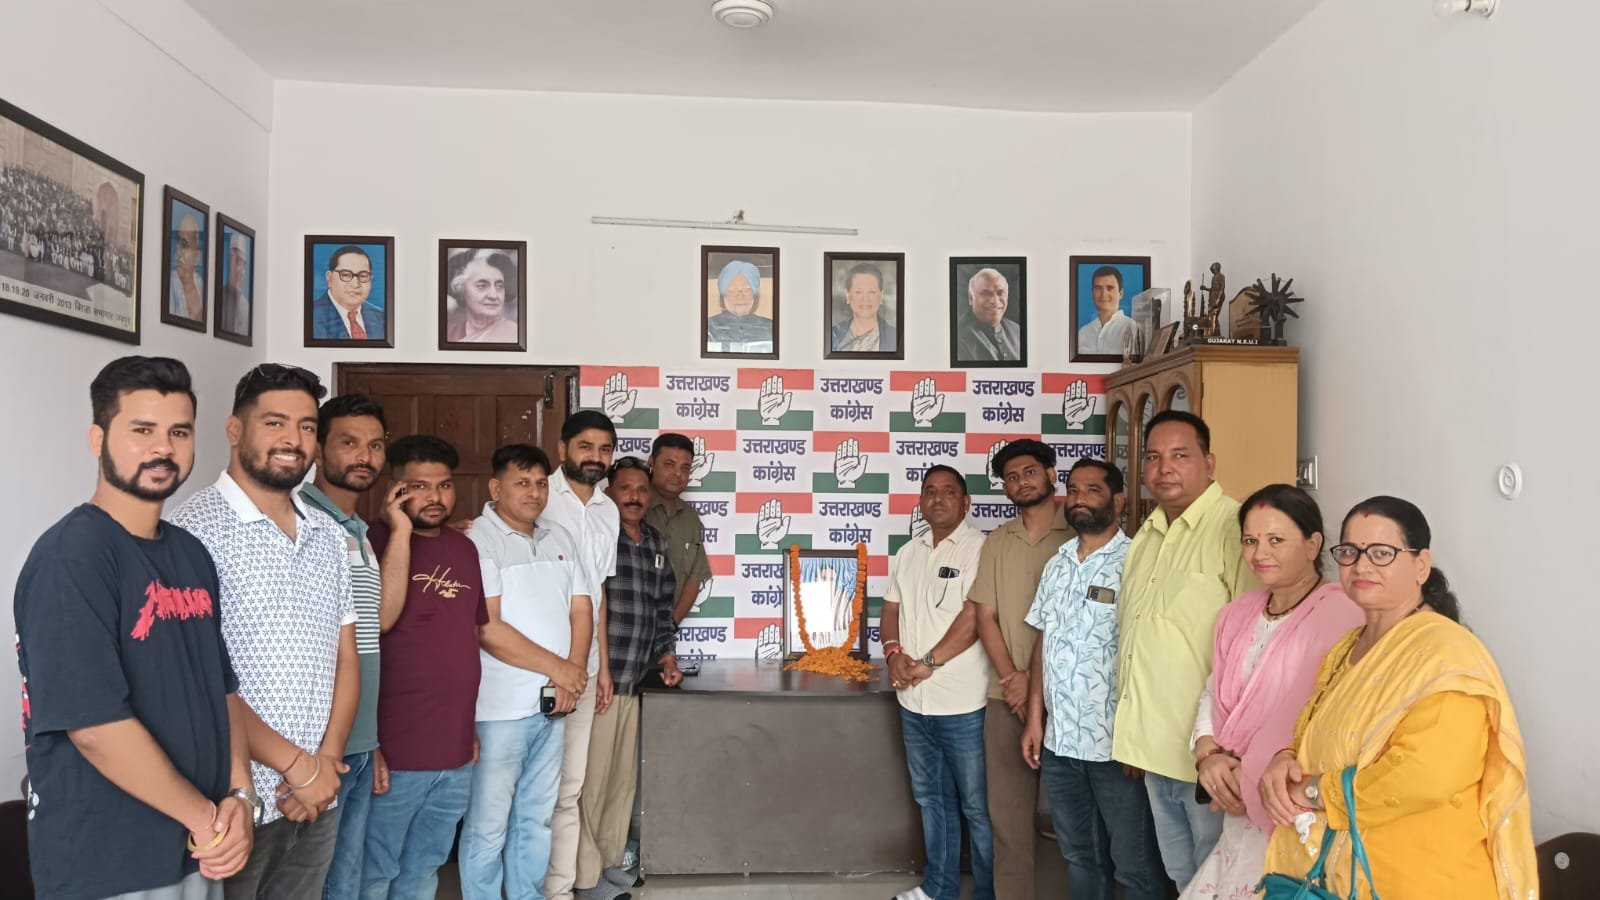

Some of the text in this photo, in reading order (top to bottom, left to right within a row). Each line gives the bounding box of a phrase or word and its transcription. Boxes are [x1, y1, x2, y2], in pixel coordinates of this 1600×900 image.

[666, 375, 731, 392] उत्तराखण्ड
[820, 377, 883, 394] उत्तराखण्ड
[972, 379, 1035, 397] उत्तराखण्ड
[676, 398, 720, 420] कांग्रेस
[830, 400, 873, 423] कांग्रेस
[982, 402, 1025, 424] कांग्रेस
[743, 438, 807, 455] उत्तराखण्ड
[896, 440, 959, 457] उत्तराखण्ड
[752, 462, 796, 484] कांग्रेस
[819, 501, 882, 518] उत्तराखण्ड
[829, 523, 872, 545] कांग्रेस
[751, 585, 785, 608] कांग्रे
